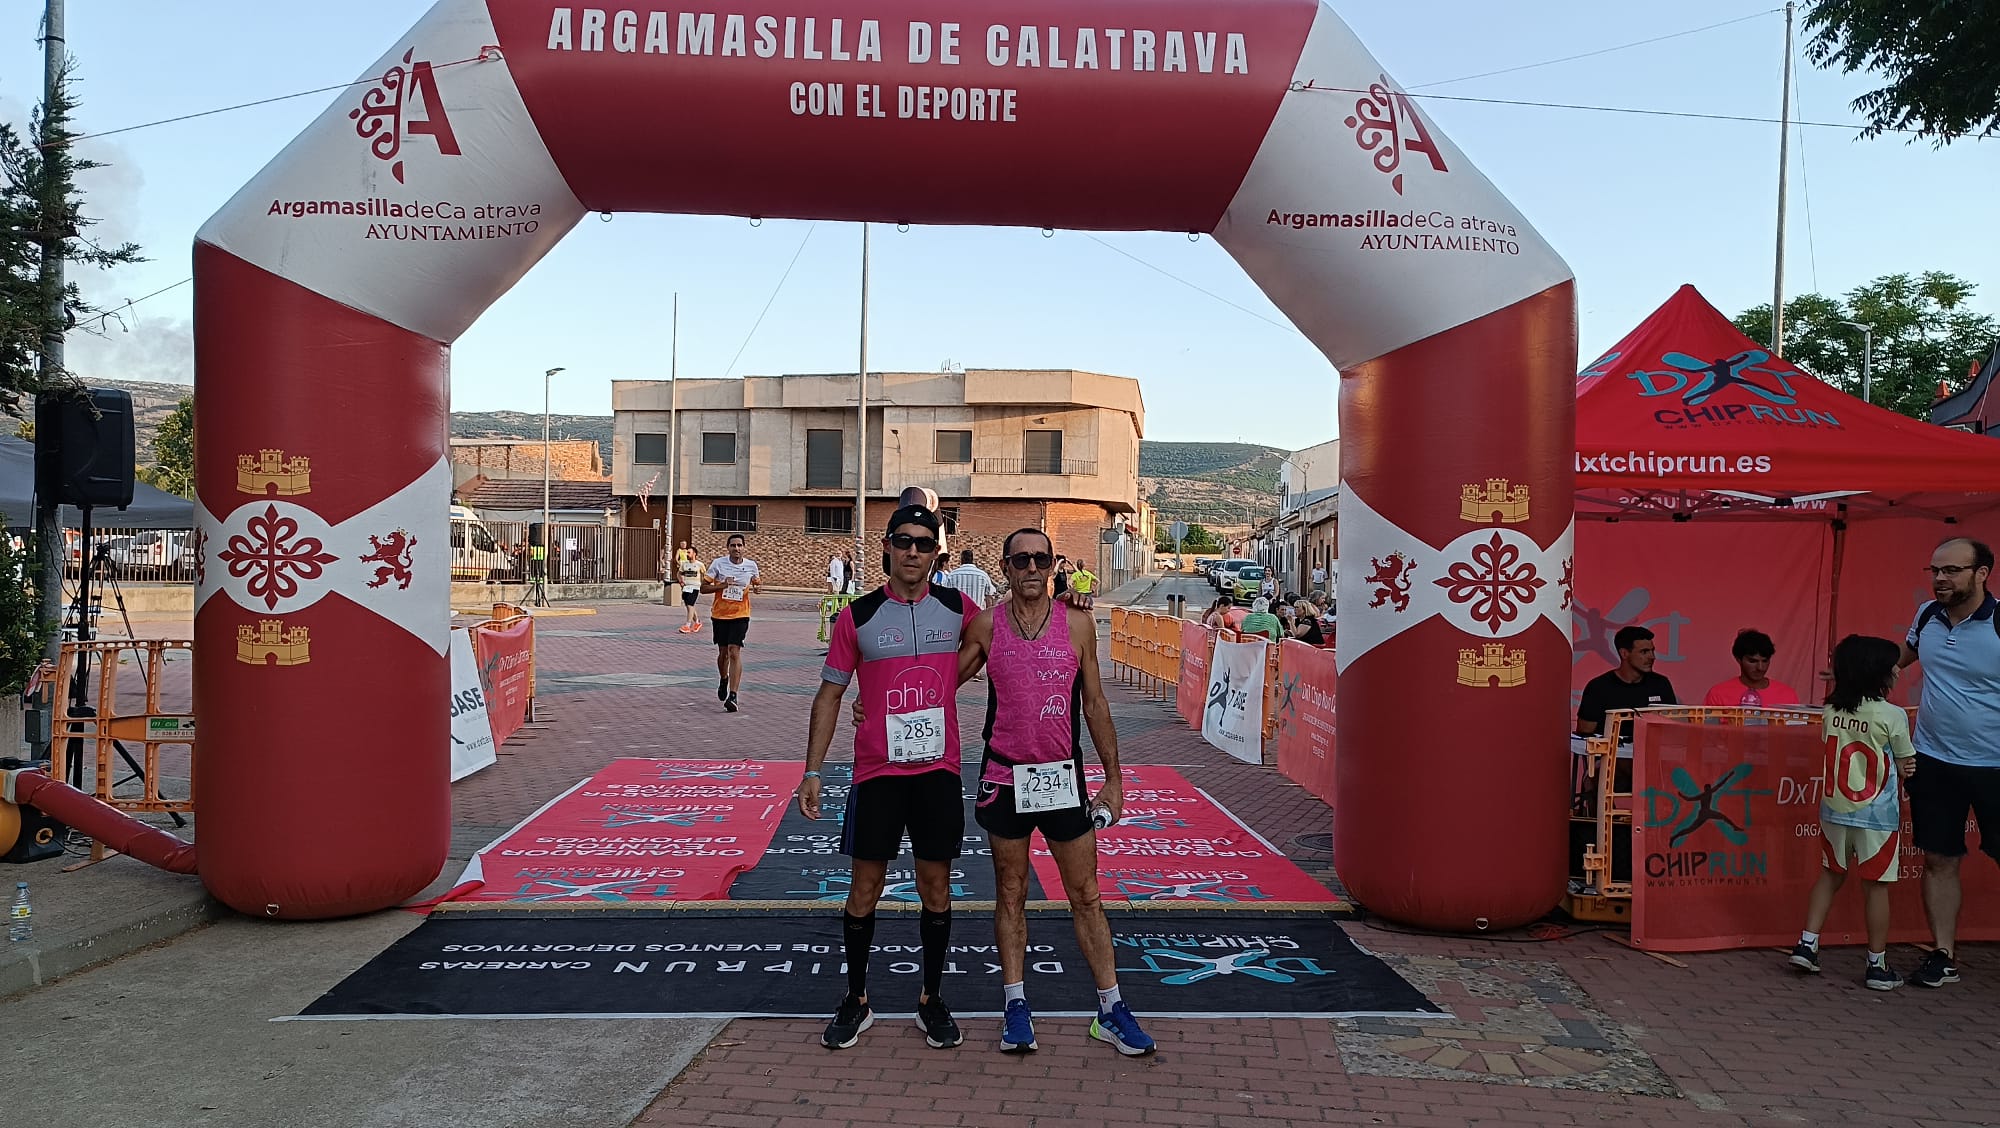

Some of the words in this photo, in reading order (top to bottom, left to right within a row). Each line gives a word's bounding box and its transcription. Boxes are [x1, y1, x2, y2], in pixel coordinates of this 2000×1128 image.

[547, 8, 882, 62] ARGAMASILLA
[908, 21, 960, 65] DE
[986, 24, 1249, 74] CALATRAVA
[790, 82, 843, 116] CON
[856, 84, 886, 118] EL
[898, 85, 1017, 122] DEPORTE
[364, 220, 539, 241] AYUNTAMIENTO
[1359, 234, 1521, 255] AYUNTAMIENTO
[1654, 404, 1840, 426] CHIPRUN
[903, 721, 934, 740] 285
[1832, 716, 1869, 734] OLMO
[1823, 735, 1879, 803] 10
[1031, 774, 1062, 792] 234
[535, 836, 738, 844] DEPORTIVOS
[556, 843, 705, 851] EVENTOS
[501, 849, 745, 857] ORGANIZADOR
[514, 869, 687, 879] CHIPRUN
[1644, 851, 1768, 879] CHIPRUN
[441, 944, 636, 952] DEPORTIVOS
[646, 943, 783, 952] EVENTOS
[792, 943, 830, 954] DE
[1112, 936, 1300, 950] CHIPRUN
[418, 960, 592, 971] CARRERAS
